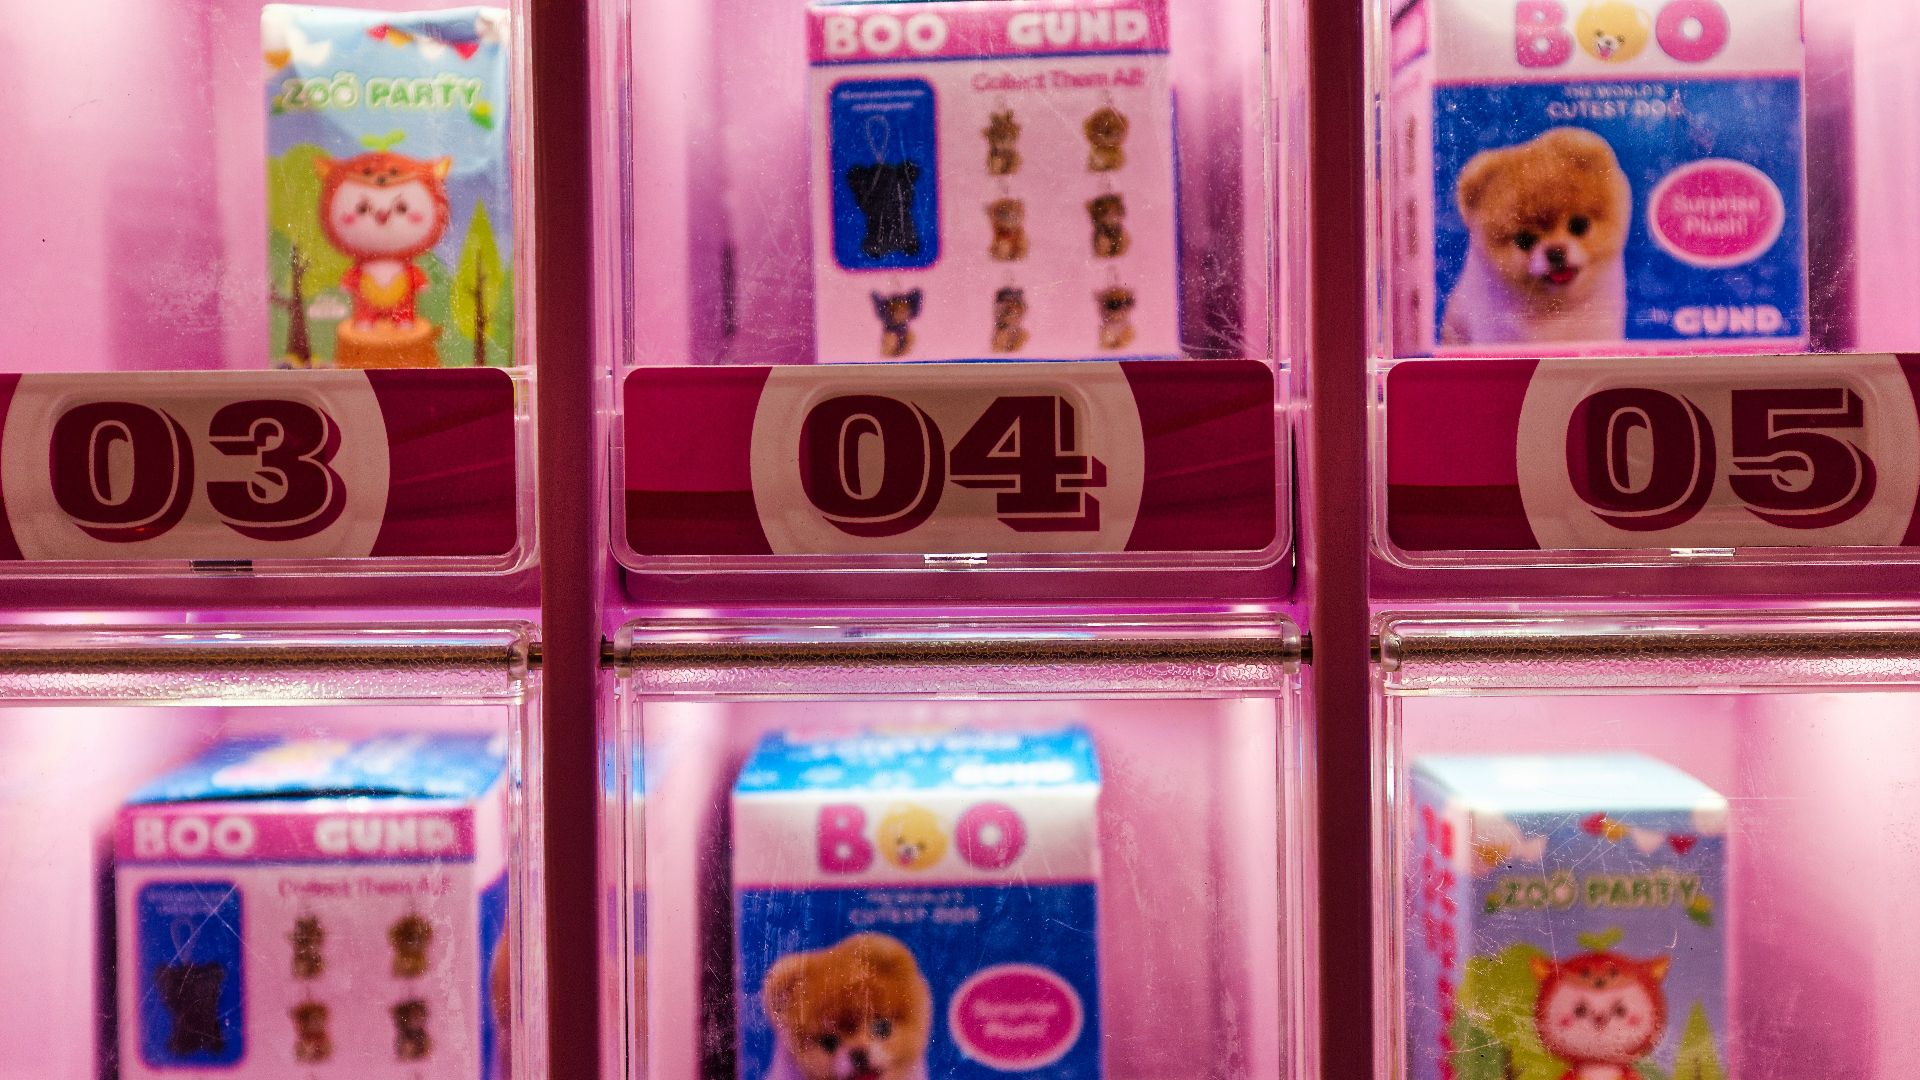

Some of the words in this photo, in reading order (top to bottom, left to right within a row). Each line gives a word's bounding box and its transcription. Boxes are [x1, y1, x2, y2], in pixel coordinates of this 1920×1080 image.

[823, 12, 948, 56] BOO
[1007, 8, 1149, 47] GUND
[366, 72, 482, 109] PARTY
[1546, 100, 1627, 120] CUTEST
[1672, 304, 1784, 336] GUND
[49, 400, 347, 543] 03
[799, 394, 1107, 538] 04
[1566, 387, 1877, 532] 05
[132, 814, 256, 859] BOO
[313, 816, 456, 855] GUND
[1584, 867, 1699, 910] PARTY
